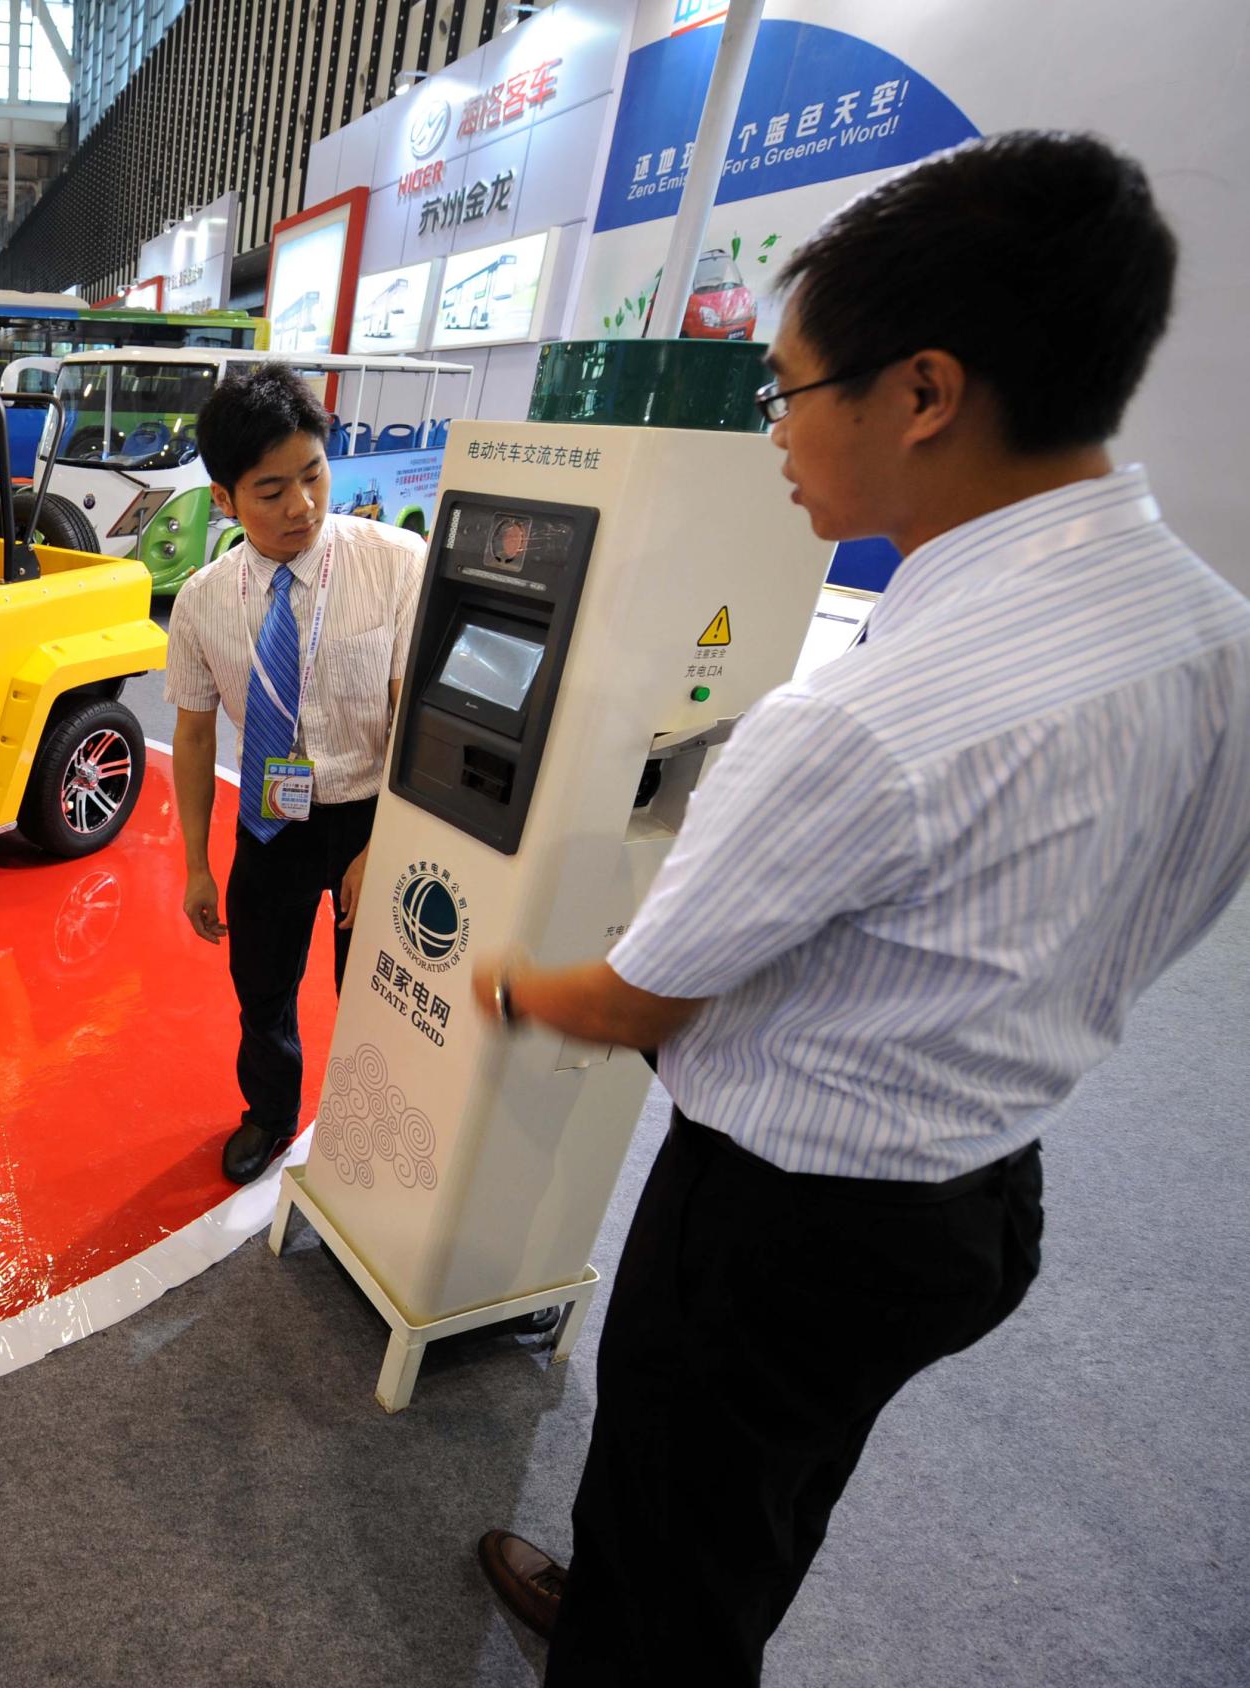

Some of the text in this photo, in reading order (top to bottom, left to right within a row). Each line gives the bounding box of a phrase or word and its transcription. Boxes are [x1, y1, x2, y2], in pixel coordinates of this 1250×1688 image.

[457, 58, 562, 138] 海格客车
[397, 160, 446, 200] HIGER
[628, 183, 656, 200] Zero
[722, 159, 750, 176] For
[750, 156, 760, 169] a
[765, 135, 837, 166] Greener
[841, 115, 900, 146] Word!
[418, 169, 514, 237] 苏州金龙
[467, 439, 603, 471] 电动汽车交流充电桩
[684, 664, 723, 679] 充电口A
[694, 648, 727, 660] 注意安全
[408, 861, 468, 910] 国家电网公司
[392, 873, 470, 973] STATE GRID CORPORATION OF CHINA
[370, 975, 445, 1048] STATE GRID
[375, 950, 451, 1028] 国家电网
